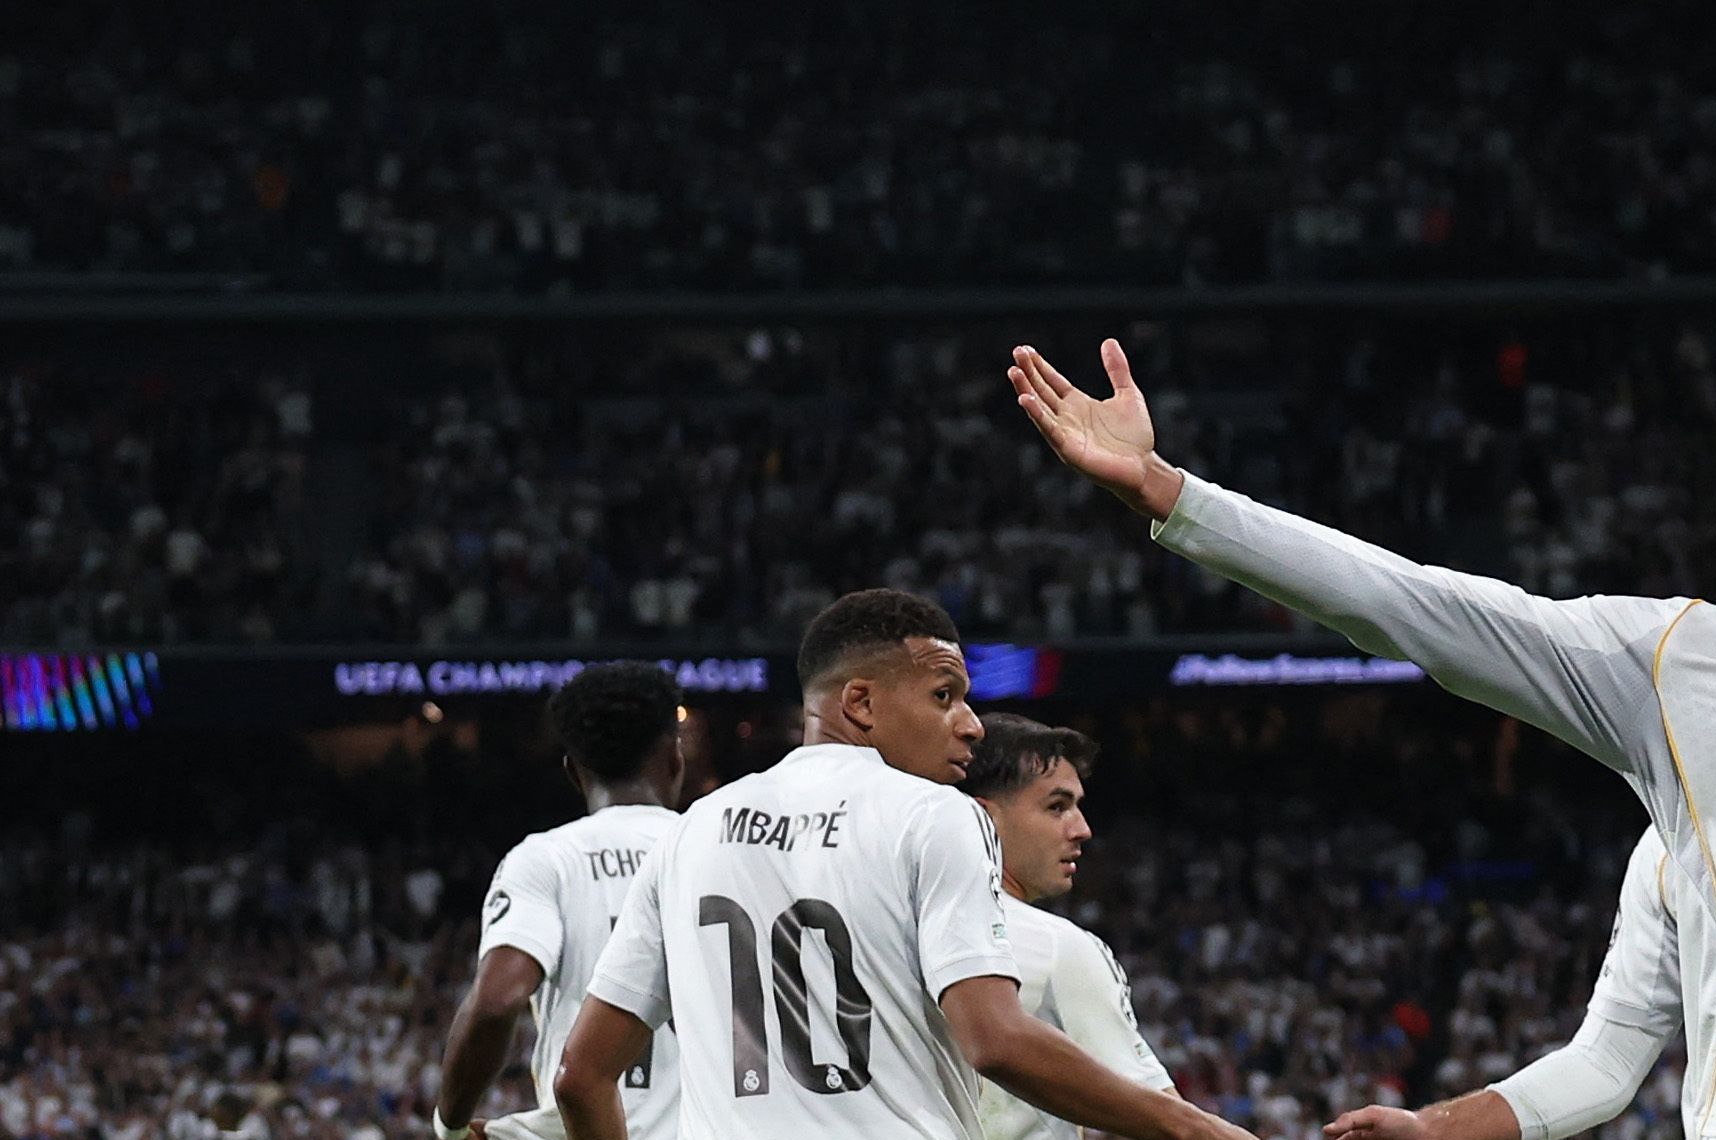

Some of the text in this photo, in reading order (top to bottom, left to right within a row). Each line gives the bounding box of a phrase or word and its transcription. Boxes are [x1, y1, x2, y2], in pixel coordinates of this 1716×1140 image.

[334, 660, 424, 695] UEFA
[718, 799, 849, 852] MBAPPÉ
[699, 894, 873, 1097] 10
